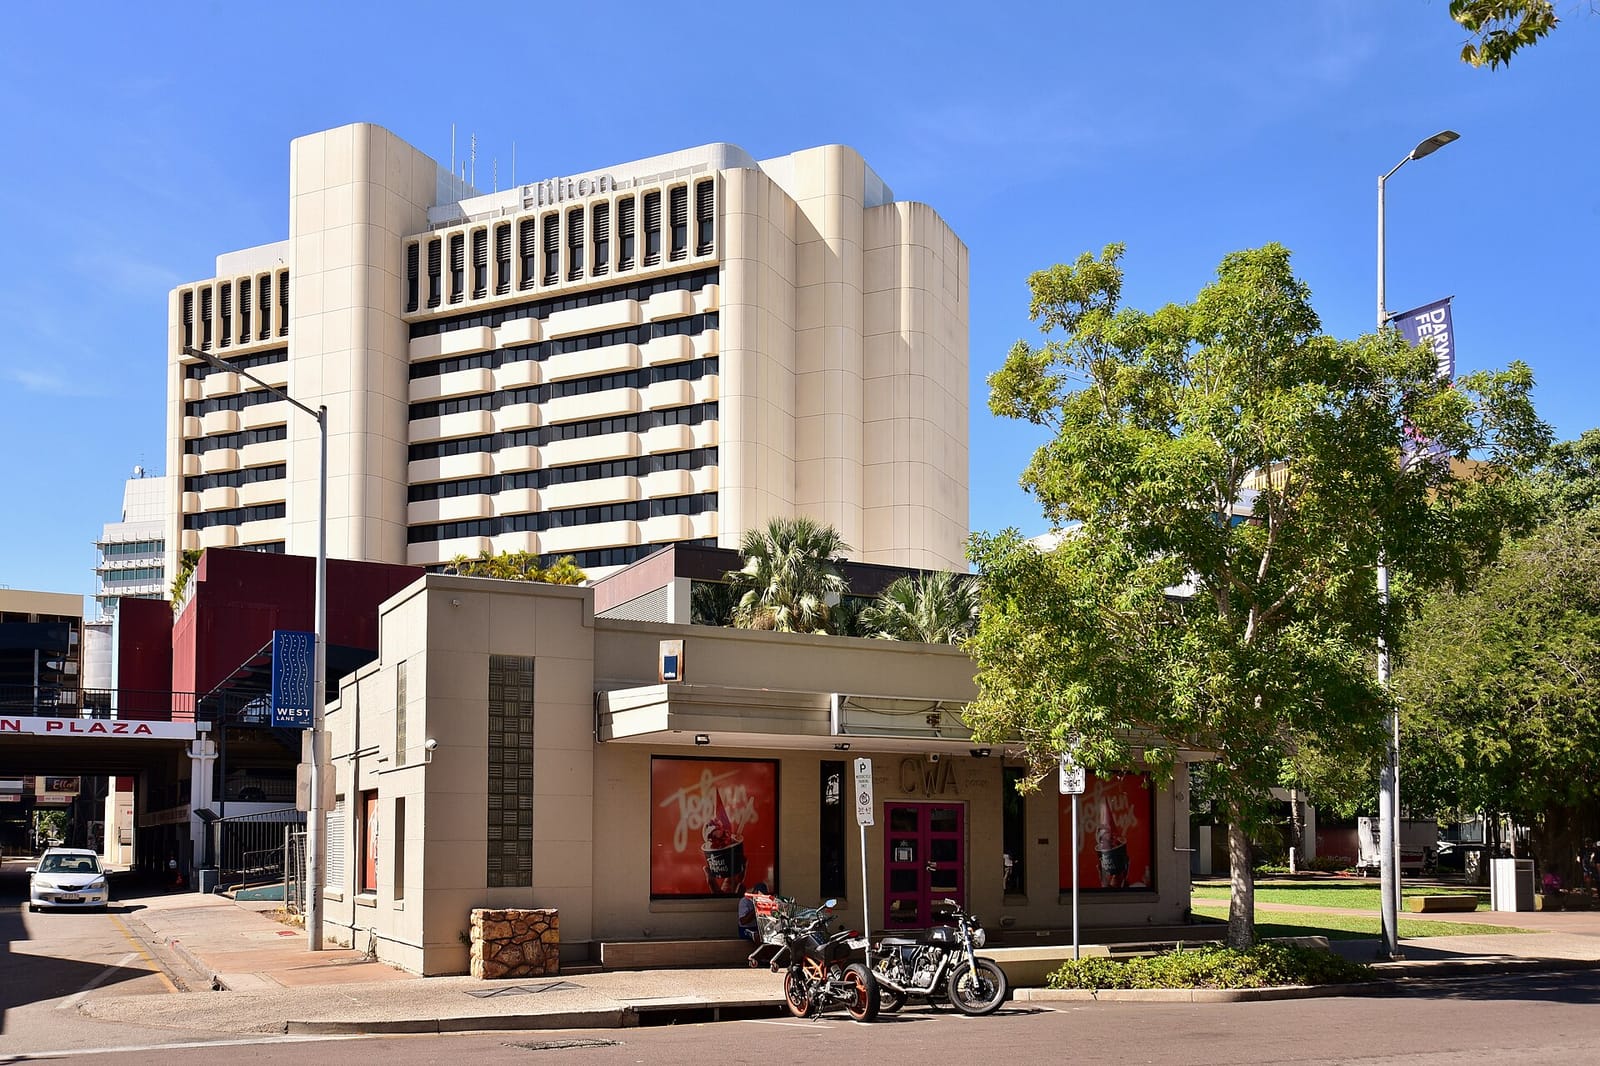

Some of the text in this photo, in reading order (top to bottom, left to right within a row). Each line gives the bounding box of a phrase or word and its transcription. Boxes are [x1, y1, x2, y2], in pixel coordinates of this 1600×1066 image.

[519, 174, 616, 210] Hilton
[1430, 307, 1451, 378] DARWIN
[277, 708, 310, 716] WEST
[46, 721, 153, 735] PLAZA
[860, 761, 867, 773] P
[900, 754, 961, 795] CWA
